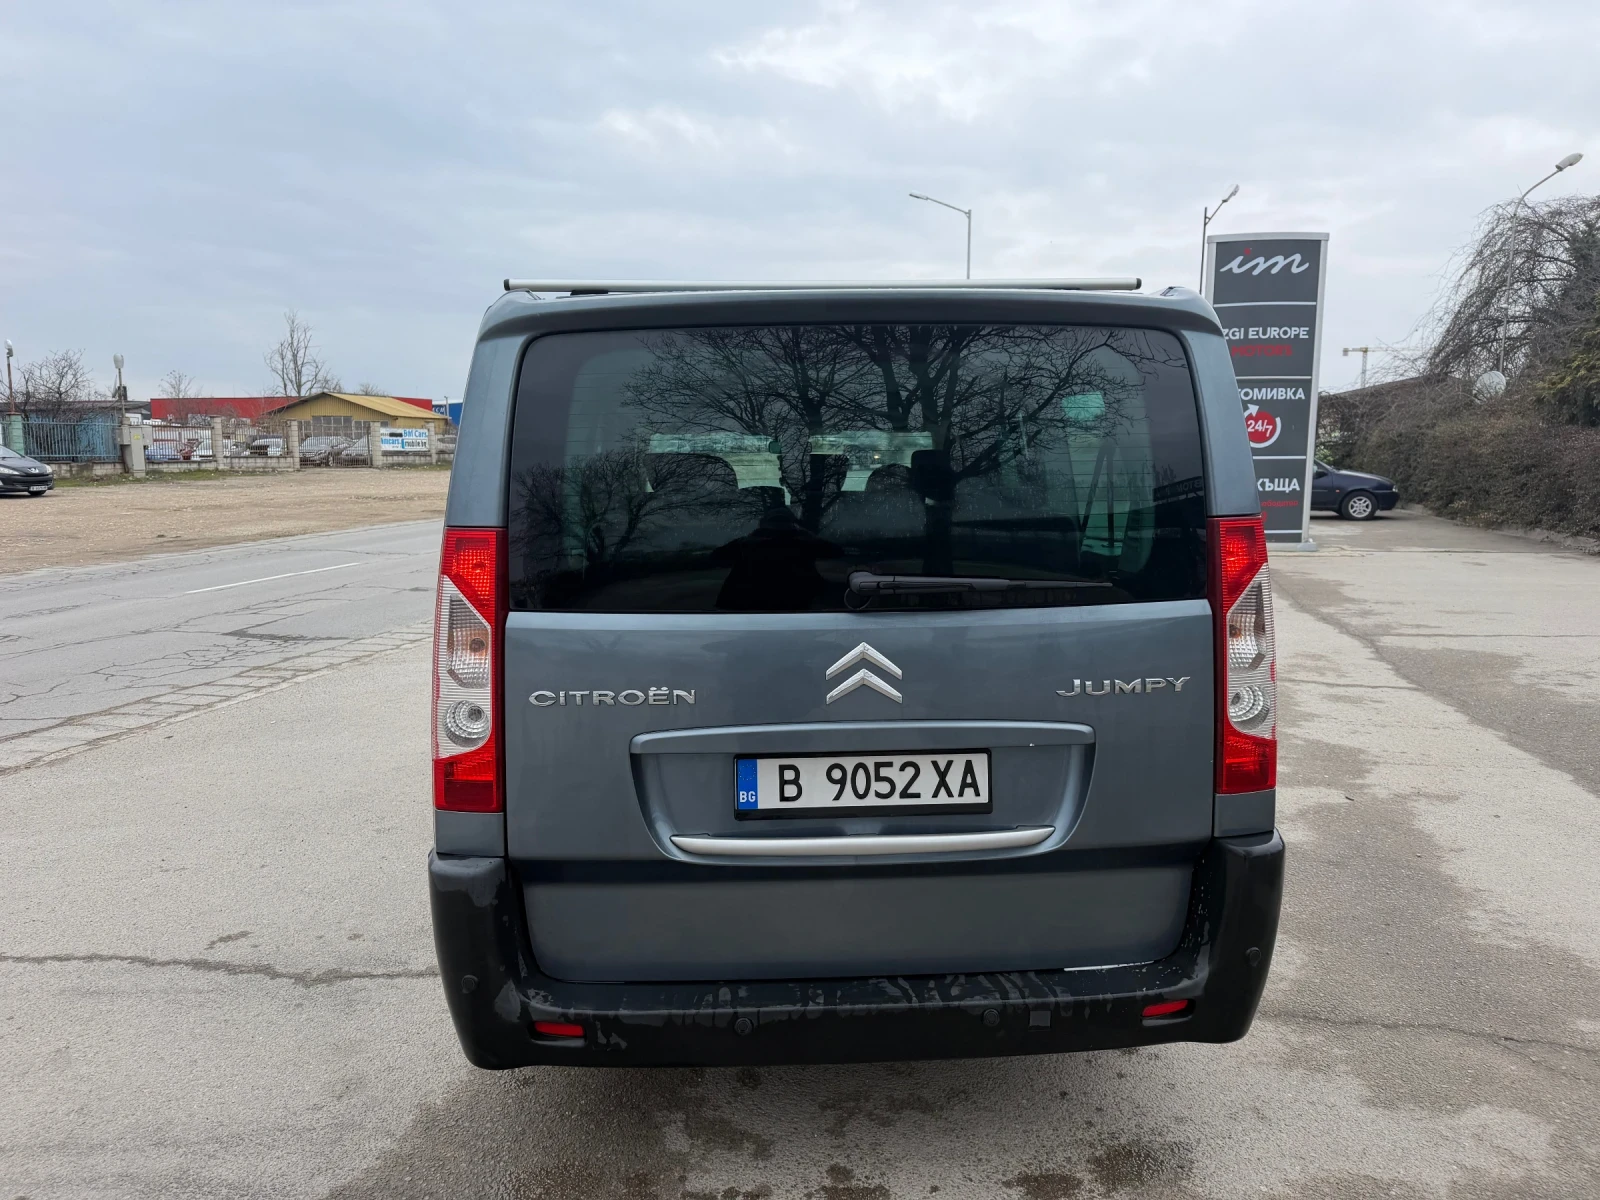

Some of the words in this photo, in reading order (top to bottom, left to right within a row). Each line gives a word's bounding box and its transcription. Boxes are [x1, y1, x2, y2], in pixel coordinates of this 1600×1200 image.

[1220, 247, 1310, 276] im
[1248, 327, 1310, 339] EUROPE
[1231, 344, 1293, 358] MOTORS
[1247, 419, 1273, 437] 24/7
[1055, 676, 1191, 697] JUMPY
[528, 686, 696, 707] CITROËN
[778, 764, 803, 802] B
[826, 761, 921, 801] 9052
[931, 759, 981, 798] XA
[739, 791, 756, 803] BG
